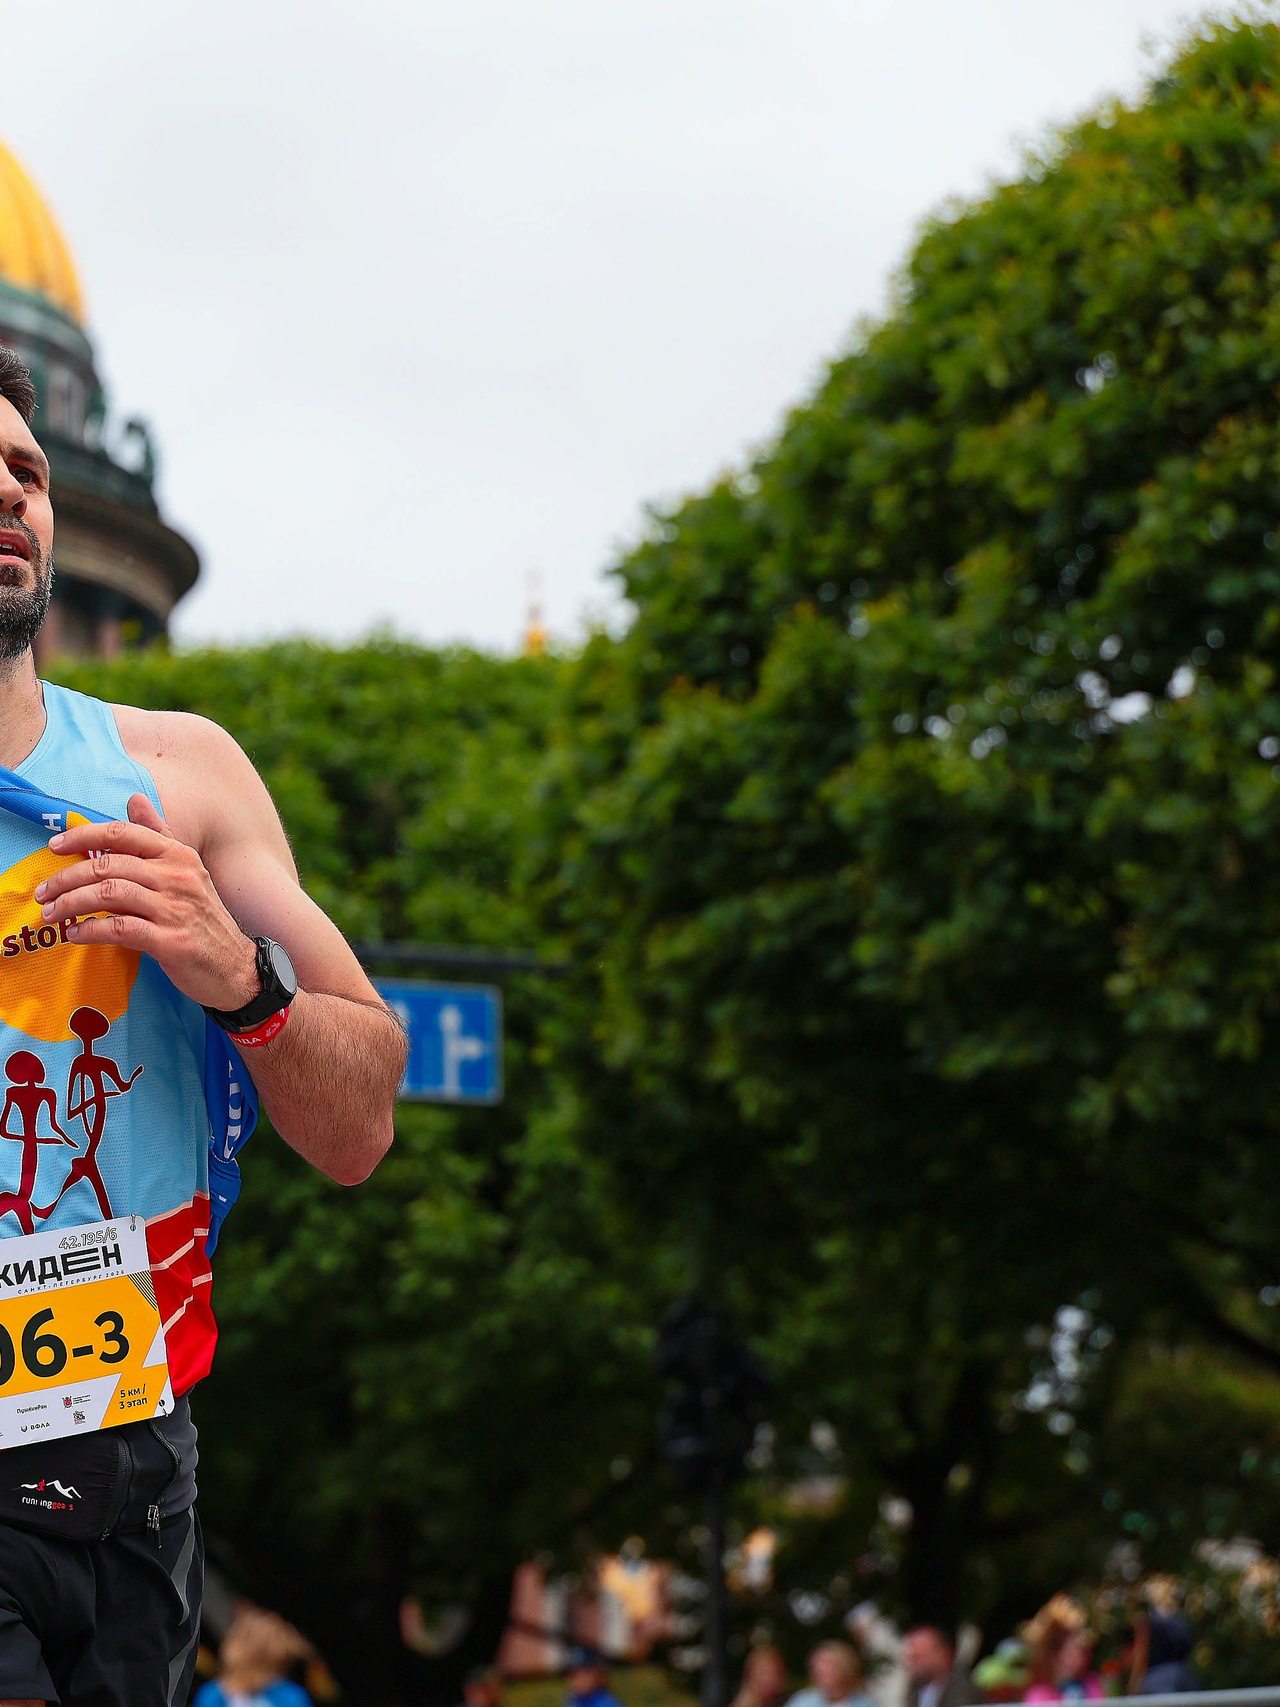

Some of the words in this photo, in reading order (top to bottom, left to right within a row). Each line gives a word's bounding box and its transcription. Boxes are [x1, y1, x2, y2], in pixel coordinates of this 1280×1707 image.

[58, 1227, 118, 1250] 42.195/6
[17, 1274, 102, 1295] САНКТ-ПЕТЕРБУРГ
[120, 1389, 126, 1398] 5
[128, 1387, 141, 1397] км
[119, 1401, 125, 1410] 3
[126, 1397, 148, 1408] этап
[30, 1421, 50, 1431] ВФЛА
